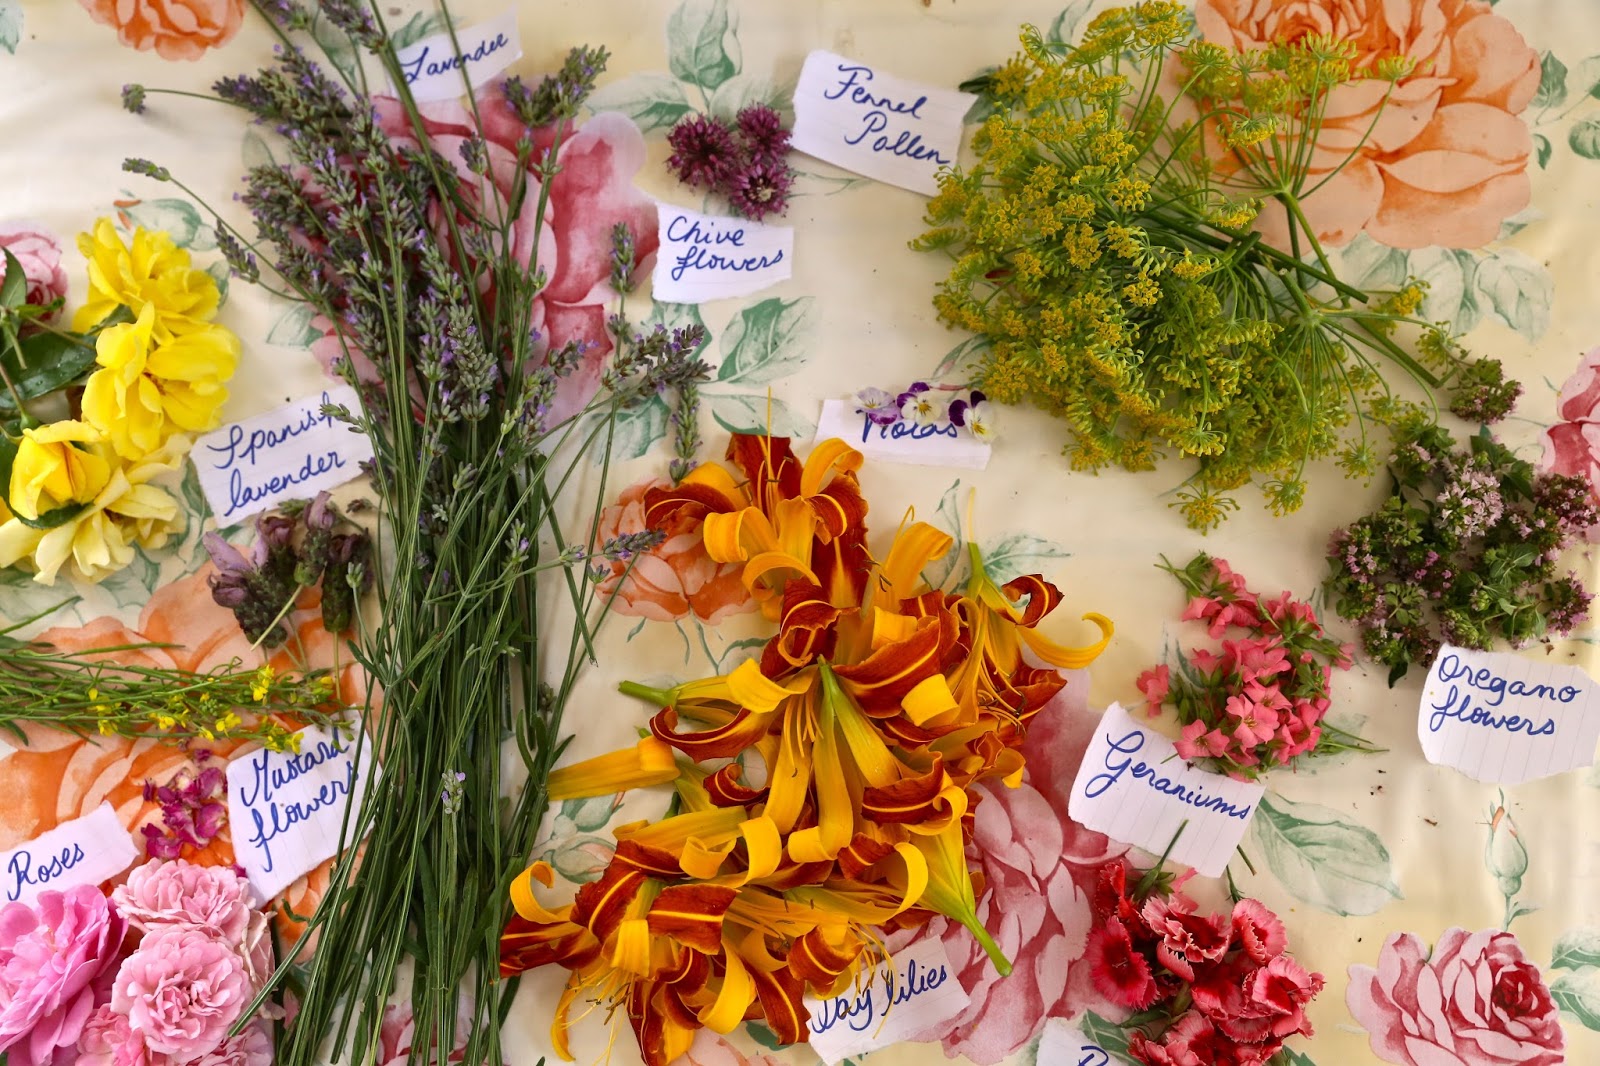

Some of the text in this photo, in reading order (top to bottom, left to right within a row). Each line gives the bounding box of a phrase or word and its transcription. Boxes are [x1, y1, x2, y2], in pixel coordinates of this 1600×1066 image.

[824, 64, 928, 120] Fennel
[844, 111, 951, 164] Pollen
[667, 215, 745, 246] Chive
[671, 245, 784, 282] flowers
[224, 451, 347, 517] lavender
[1438, 654, 1582, 706] Oregano
[1429, 685, 1555, 732] flowers
[1085, 730, 1251, 819] Geraniums
[7, 843, 85, 901] Roses
